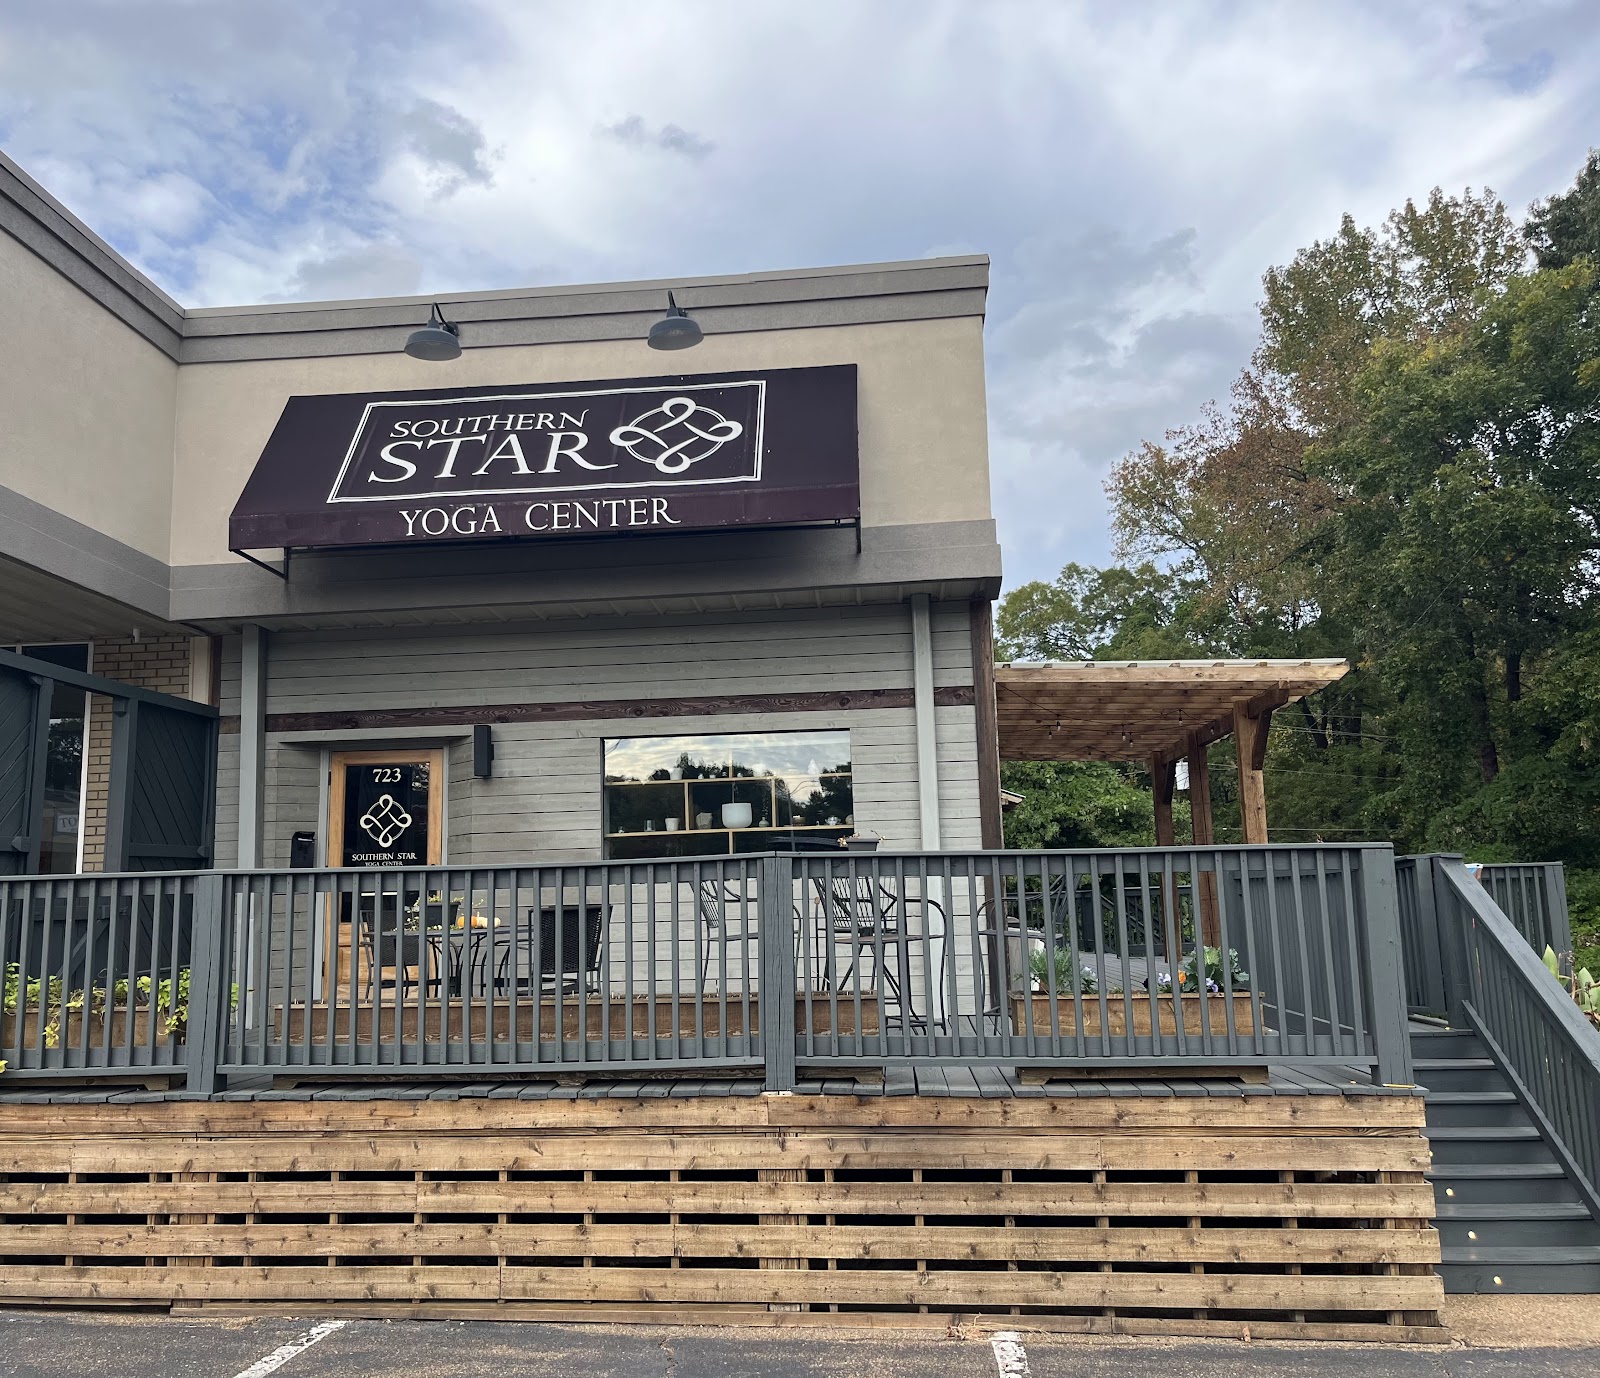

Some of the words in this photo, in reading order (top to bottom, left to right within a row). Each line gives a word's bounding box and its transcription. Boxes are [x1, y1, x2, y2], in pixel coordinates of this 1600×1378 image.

[390, 408, 589, 438] SOUTHERN
[367, 430, 619, 483] STAR
[398, 505, 503, 537] YOGA
[525, 497, 681, 531] CENTER
[372, 768, 402, 783] 723
[351, 852, 394, 861] SOUTHERN
[397, 852, 417, 860] STAR
